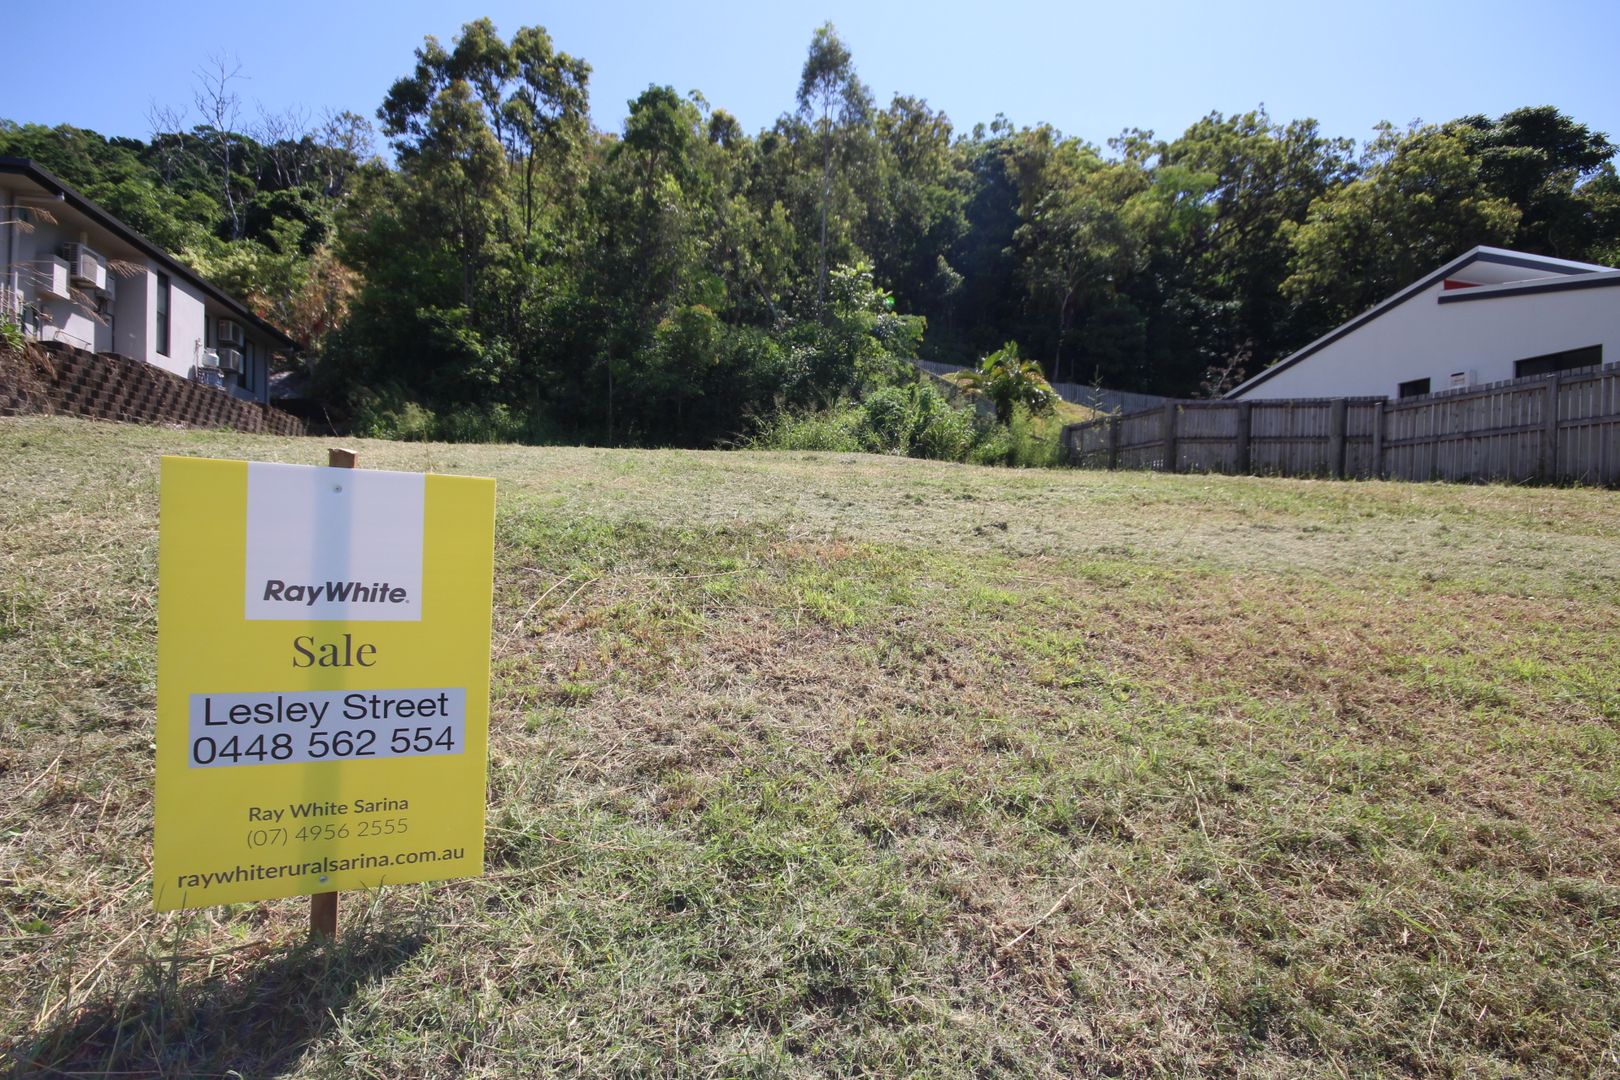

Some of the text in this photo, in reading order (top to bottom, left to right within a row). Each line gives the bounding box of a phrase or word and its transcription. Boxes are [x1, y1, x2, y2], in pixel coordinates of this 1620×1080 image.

[292, 633, 377, 668] Sale
[204, 692, 449, 728] Lesley Street
[193, 726, 455, 765] 0448 562 554
[249, 797, 409, 822] Ray White Sarina
[247, 817, 408, 849] (07) 4956 2555
[178, 847, 465, 889] raywhiteruralsarina.com.au
